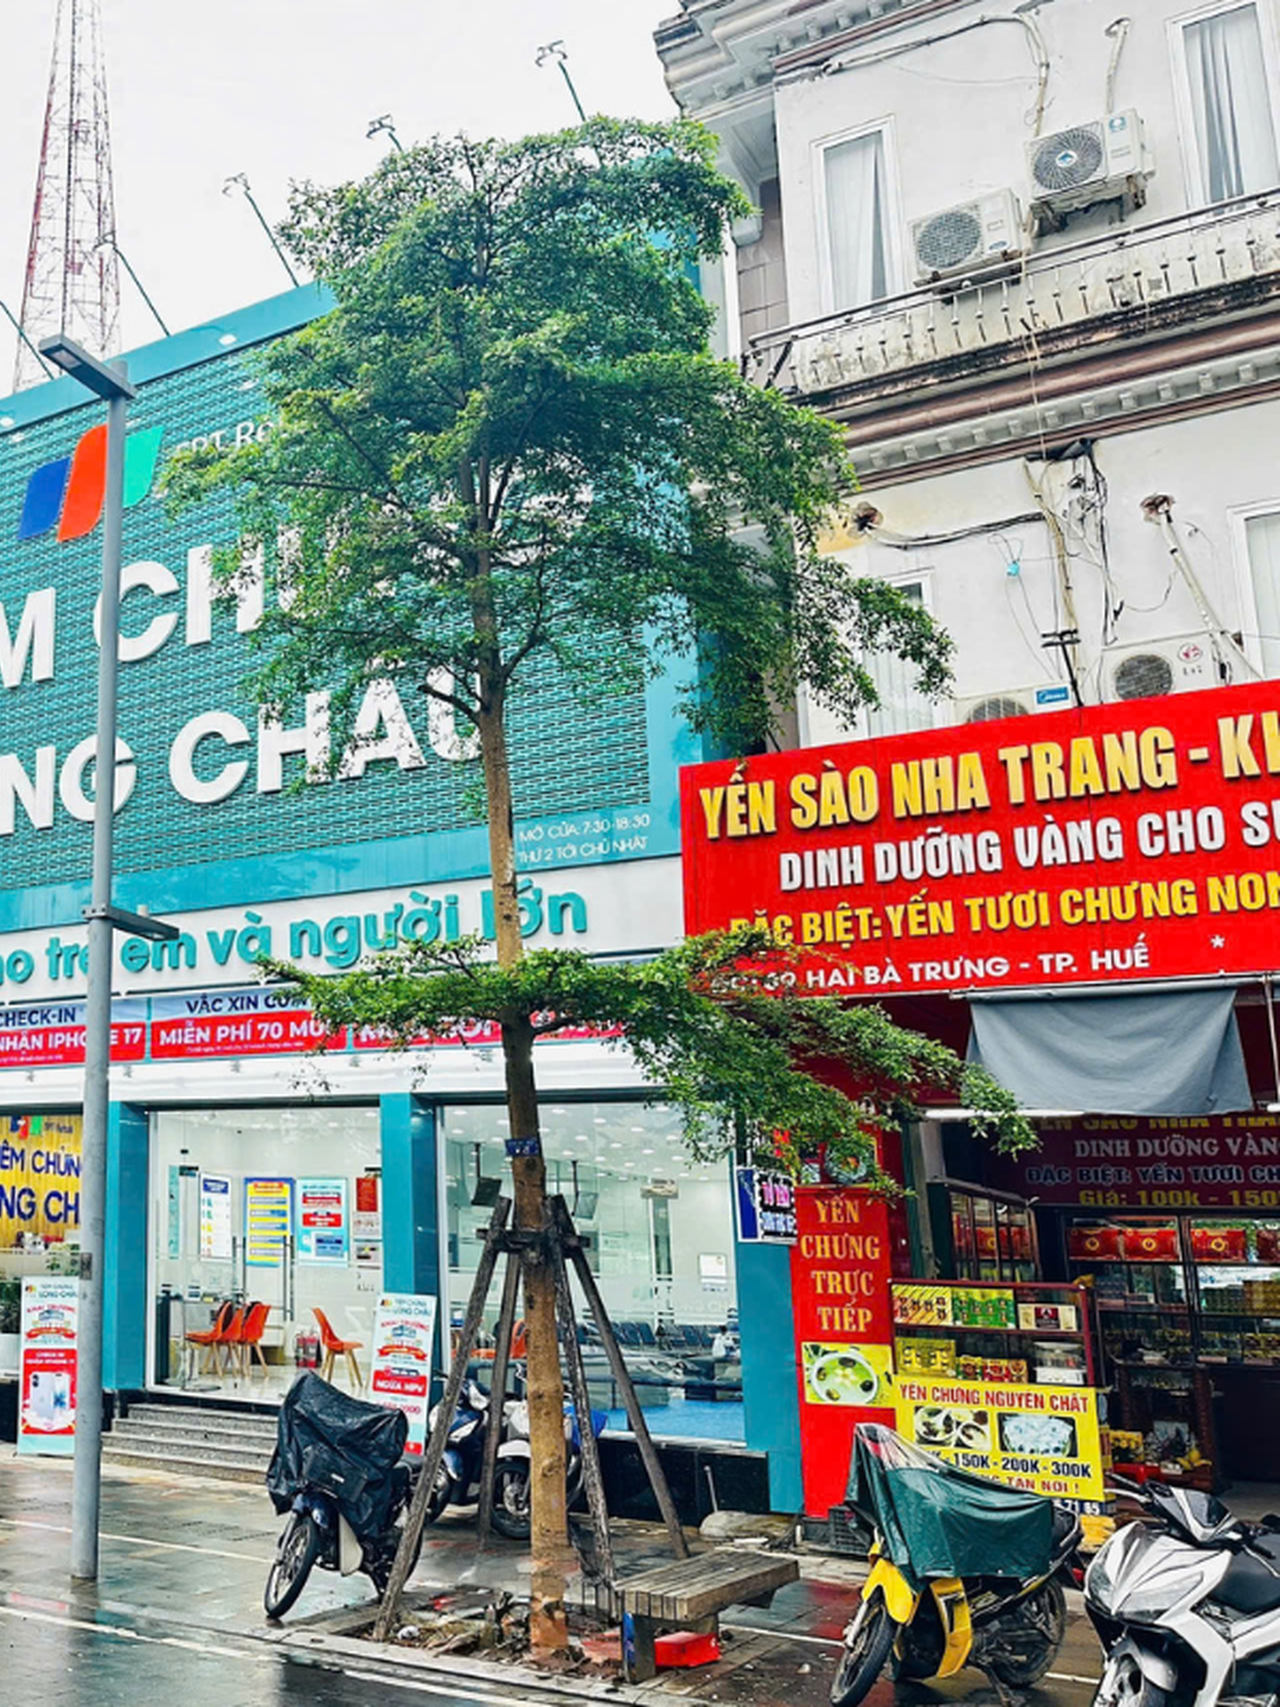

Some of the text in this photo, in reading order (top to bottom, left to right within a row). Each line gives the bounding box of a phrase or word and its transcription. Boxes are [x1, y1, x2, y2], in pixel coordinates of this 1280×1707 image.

[699, 762, 776, 840] YẾN
[790, 759, 880, 830] SÀO
[891, 752, 990, 819] NHA
[998, 727, 1178, 802] TRANG
[544, 849, 554, 861] 2
[779, 847, 864, 892] DINH
[875, 826, 1003, 883] DƯỠNG
[1013, 813, 1123, 869] VÀNG
[1136, 805, 1226, 858] CHO
[885, 886, 955, 938] YẾN
[965, 886, 1051, 932] TƯƠI
[1059, 878, 1199, 923] CHƯNG
[120, 930, 197, 973] em
[206, 910, 273, 966] và
[289, 890, 460, 969] người
[806, 965, 855, 989] HAI
[864, 957, 902, 985] BÀ
[908, 954, 1010, 982] TRƯNG
[1038, 952, 1080, 976] TP.
[1090, 932, 1150, 970] HUẾ
[228, 994, 259, 1012] XIN
[48, 1028, 120, 1050] IPHOE
[123, 1027, 143, 1045] 17
[216, 1018, 253, 1043] PHÍ
[257, 1022, 284, 1041] 70
[1074, 1139, 1131, 1157] DINH
[1225, 1132, 1280, 1156] VÀN
[31, 1145, 82, 1179] CHỦN
[43, 1190, 81, 1226] CH
[815, 1192, 860, 1224] YẾN
[1136, 1190, 1201, 1206] 100k
[1228, 1190, 1280, 1206] 150
[800, 1232, 881, 1260] CHƯNG
[810, 1268, 875, 1297] TRỰC
[816, 1297, 874, 1333] TIẾP
[953, 1452, 991, 1469] 150K
[1001, 1456, 1041, 1474] 200K
[1051, 1461, 1092, 1479] 300K
